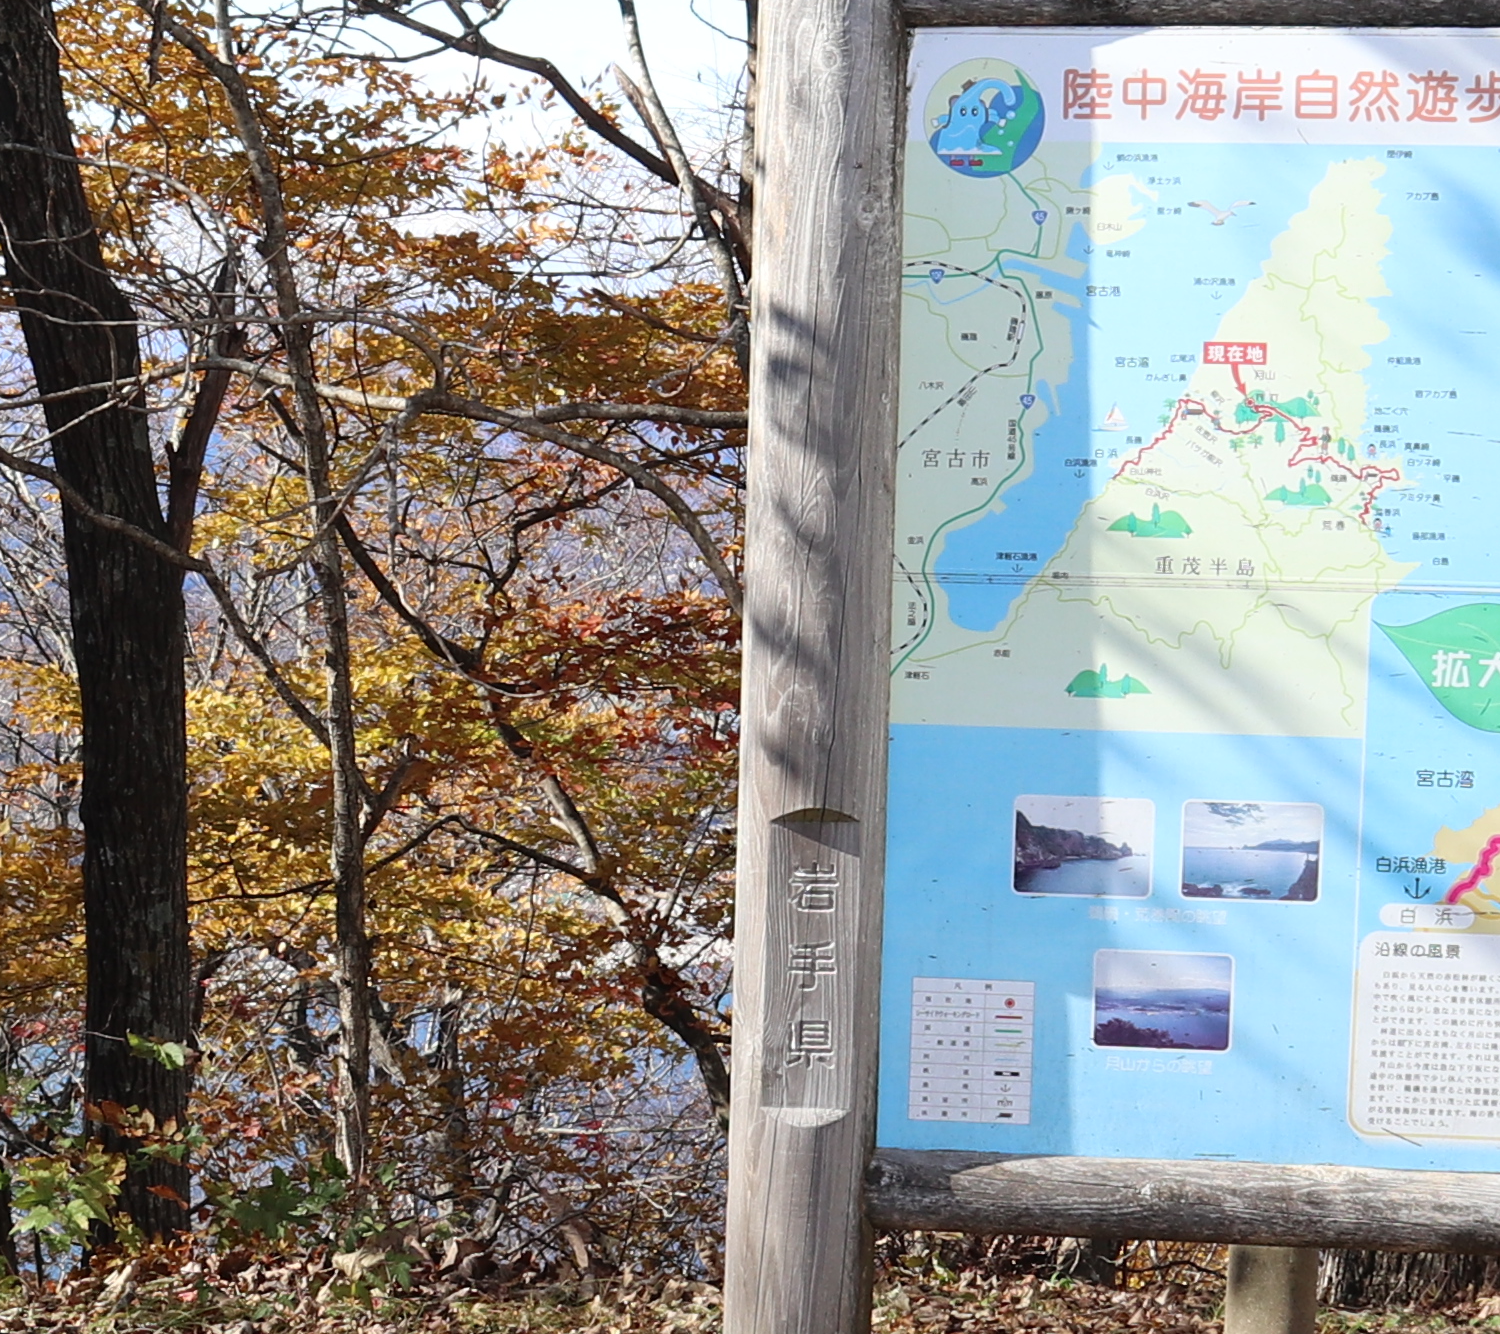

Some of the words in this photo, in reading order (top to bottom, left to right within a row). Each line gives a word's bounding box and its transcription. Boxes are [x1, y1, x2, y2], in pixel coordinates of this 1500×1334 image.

[1207, 345, 1264, 363] 現在地
[921, 448, 990, 469] 宮古市
[1155, 555, 1255, 577] 重茂半島
[1416, 769, 1475, 788] 宮古湾
[1376, 856, 1446, 875] 白浜漁港
[1400, 906, 1453, 925] 白浜
[1374, 942, 1461, 959] 沿線の風景
[785, 861, 839, 1069] 岩手県
